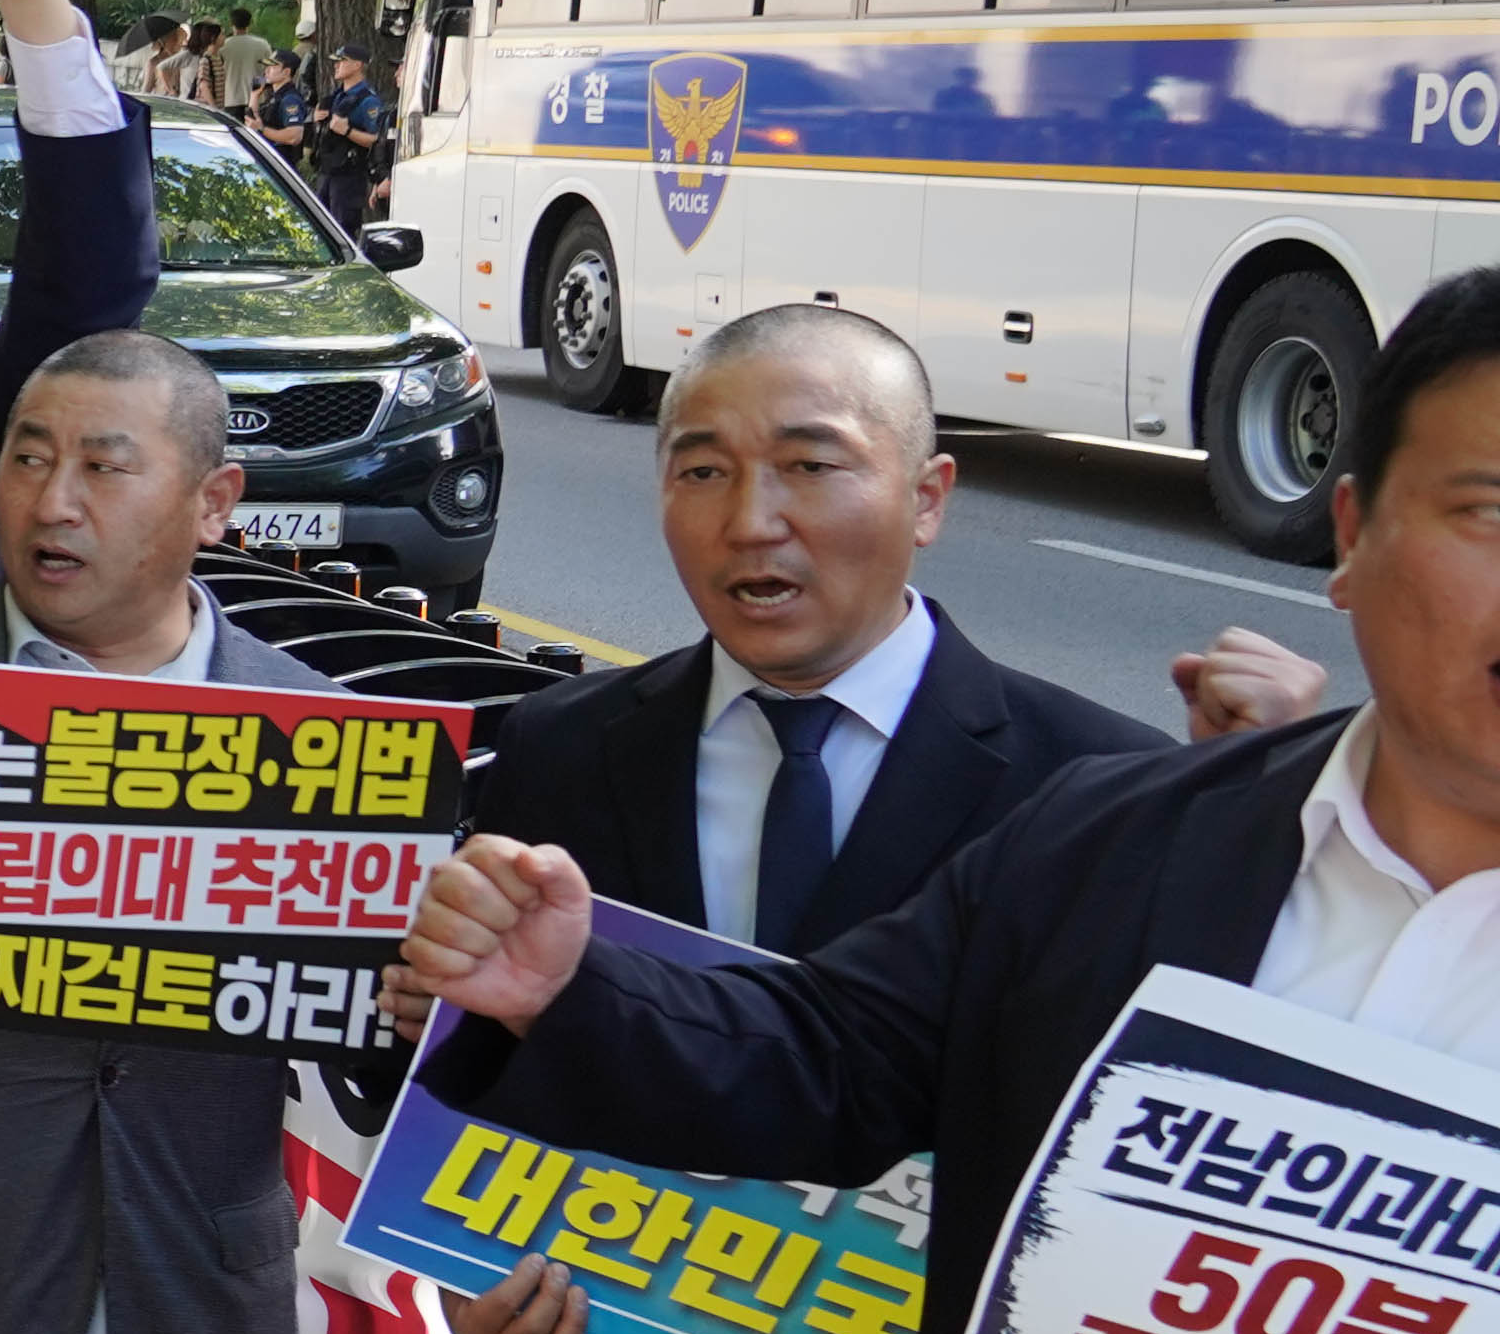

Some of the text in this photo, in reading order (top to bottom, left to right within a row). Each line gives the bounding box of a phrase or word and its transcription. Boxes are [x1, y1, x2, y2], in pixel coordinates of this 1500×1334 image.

[669, 192, 708, 214] POLICE
[245, 514, 322, 540] 4674
[208, 836, 419, 930] 추천안
